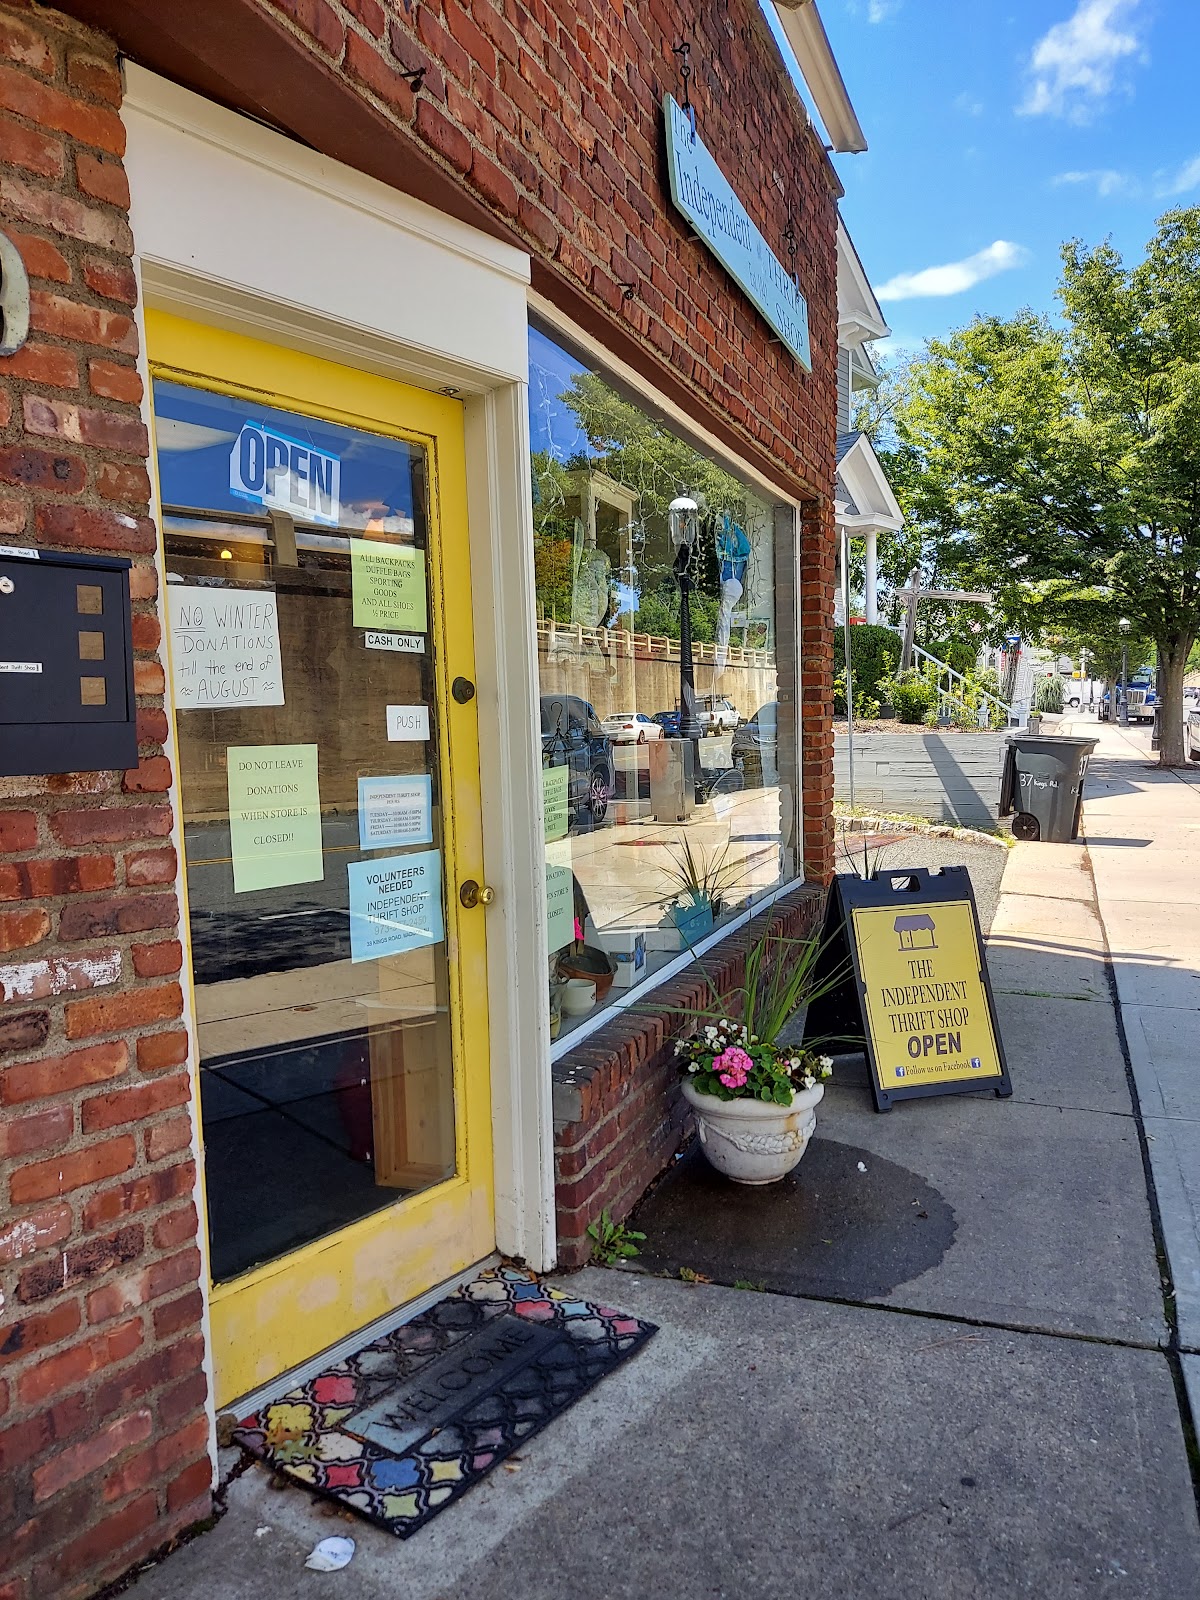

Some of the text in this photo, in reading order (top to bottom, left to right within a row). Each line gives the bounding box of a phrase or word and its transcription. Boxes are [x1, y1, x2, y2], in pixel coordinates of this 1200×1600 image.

[671, 101, 693, 154] The
[675, 150, 752, 253] Independent
[765, 247, 806, 324] THRIFT
[775, 302, 804, 358] SHOP
[240, 427, 333, 516] OPEN
[360, 554, 416, 570] ALL BACKPACKS
[366, 566, 411, 579] DUFFLE BAGS
[369, 577, 403, 589] SPORTING
[373, 588, 398, 598] GOODS
[361, 598, 414, 610] AND ALL SHOES
[180, 603, 274, 629] NO WINTER
[379, 610, 399, 620] PRICE
[176, 634, 274, 654] DONATIONS
[368, 634, 421, 649] CASH ONLY
[178, 654, 274, 677] till the end of
[197, 676, 259, 700] AUGUST
[396, 715, 421, 730] PUSH
[239, 760, 303, 771] DO NOT LEAVE
[247, 784, 299, 796] DONATIONS
[1020, 773, 1033, 787] 37
[1034, 779, 1048, 789] Kings
[241, 807, 308, 821] WHEN STORE IS
[253, 832, 294, 845] CLOSED!!
[366, 867, 425, 885] VOLUNTEERS
[379, 879, 413, 895] NEEDED
[367, 891, 428, 912] INDEPENDENT
[368, 903, 424, 923] THRIFT SHOP
[908, 959, 935, 979] THE
[881, 980, 967, 1008] INDEPENDENT
[889, 1007, 968, 1034] THRIFT SHOP
[907, 1031, 962, 1059] OPEN
[905, 1065, 927, 1076] Follow
[934, 1064, 943, 1072] on
[942, 1059, 971, 1072] Facebook
[372, 1327, 535, 1432] WELCOME
